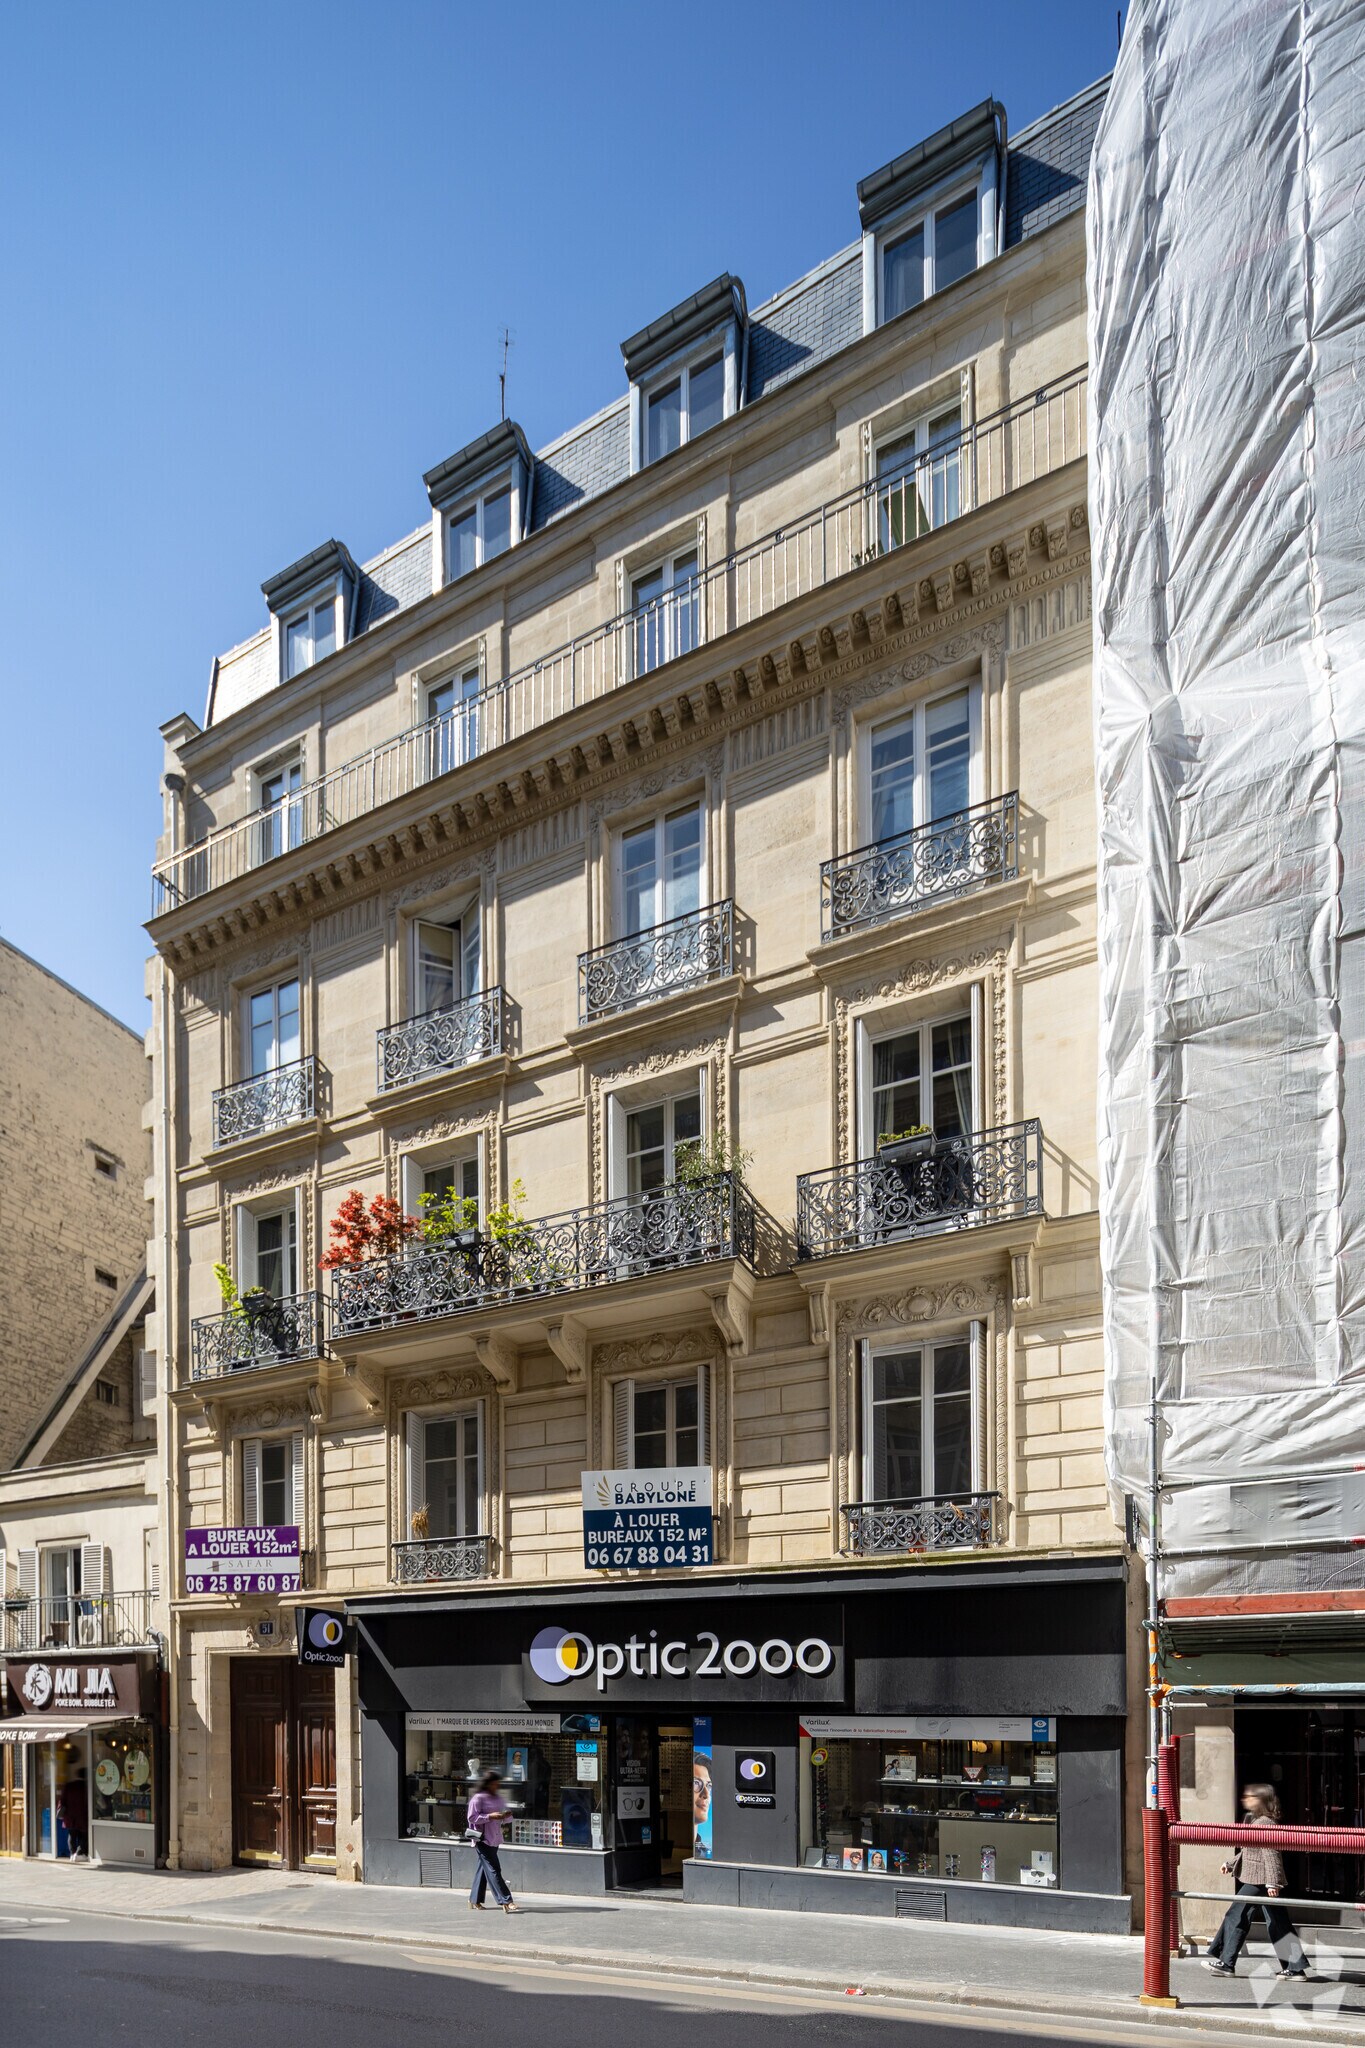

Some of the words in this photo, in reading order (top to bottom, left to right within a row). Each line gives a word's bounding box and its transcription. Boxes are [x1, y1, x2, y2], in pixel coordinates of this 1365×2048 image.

[614, 1480, 696, 1493] GROUPE
[615, 1490, 696, 1505] BABYLONE
[614, 1512, 624, 1528] À
[629, 1513, 680, 1527] LOUER
[207, 1529, 277, 1542] BUREAUX
[588, 1529, 654, 1544] BUREAUX
[658, 1529, 685, 1542] 152
[188, 1543, 198, 1555] A
[202, 1542, 250, 1555] LOUER
[588, 1548, 609, 1565] 06
[613, 1547, 633, 1564] 67
[637, 1546, 659, 1563] 88
[664, 1545, 687, 1563] 04
[692, 1545, 709, 1562] 31
[228, 1559, 273, 1568] SAFAR
[186, 1576, 204, 1592] 06
[209, 1576, 228, 1592] 25
[234, 1575, 251, 1592] 87
[257, 1575, 276, 1591] 60
[282, 1575, 300, 1591] 87
[262, 1623, 271, 1634] 51
[304, 1650, 325, 1663] Optic
[325, 1653, 344, 1663] 2000
[556, 1629, 687, 1690] Optic
[696, 1631, 832, 1675] 2000
[55, 1668, 78, 1694] MI
[83, 1668, 115, 1694] JIA
[55, 1699, 69, 1707] POKE
[69, 1699, 83, 1707] BOWL
[84, 1699, 104, 1707] BUBBLE
[105, 1699, 116, 1707] TEA
[442, 1718, 462, 1726] MARQUE
[463, 1718, 470, 1726] DE
[470, 1718, 490, 1726] VERRES
[490, 1718, 526, 1727] PROGRESSIFS
[526, 1719, 534, 1727] AU
[0, 1730, 17, 1741] OKE
[18, 1730, 38, 1741] BOWL
[738, 1795, 755, 1804] Optic
